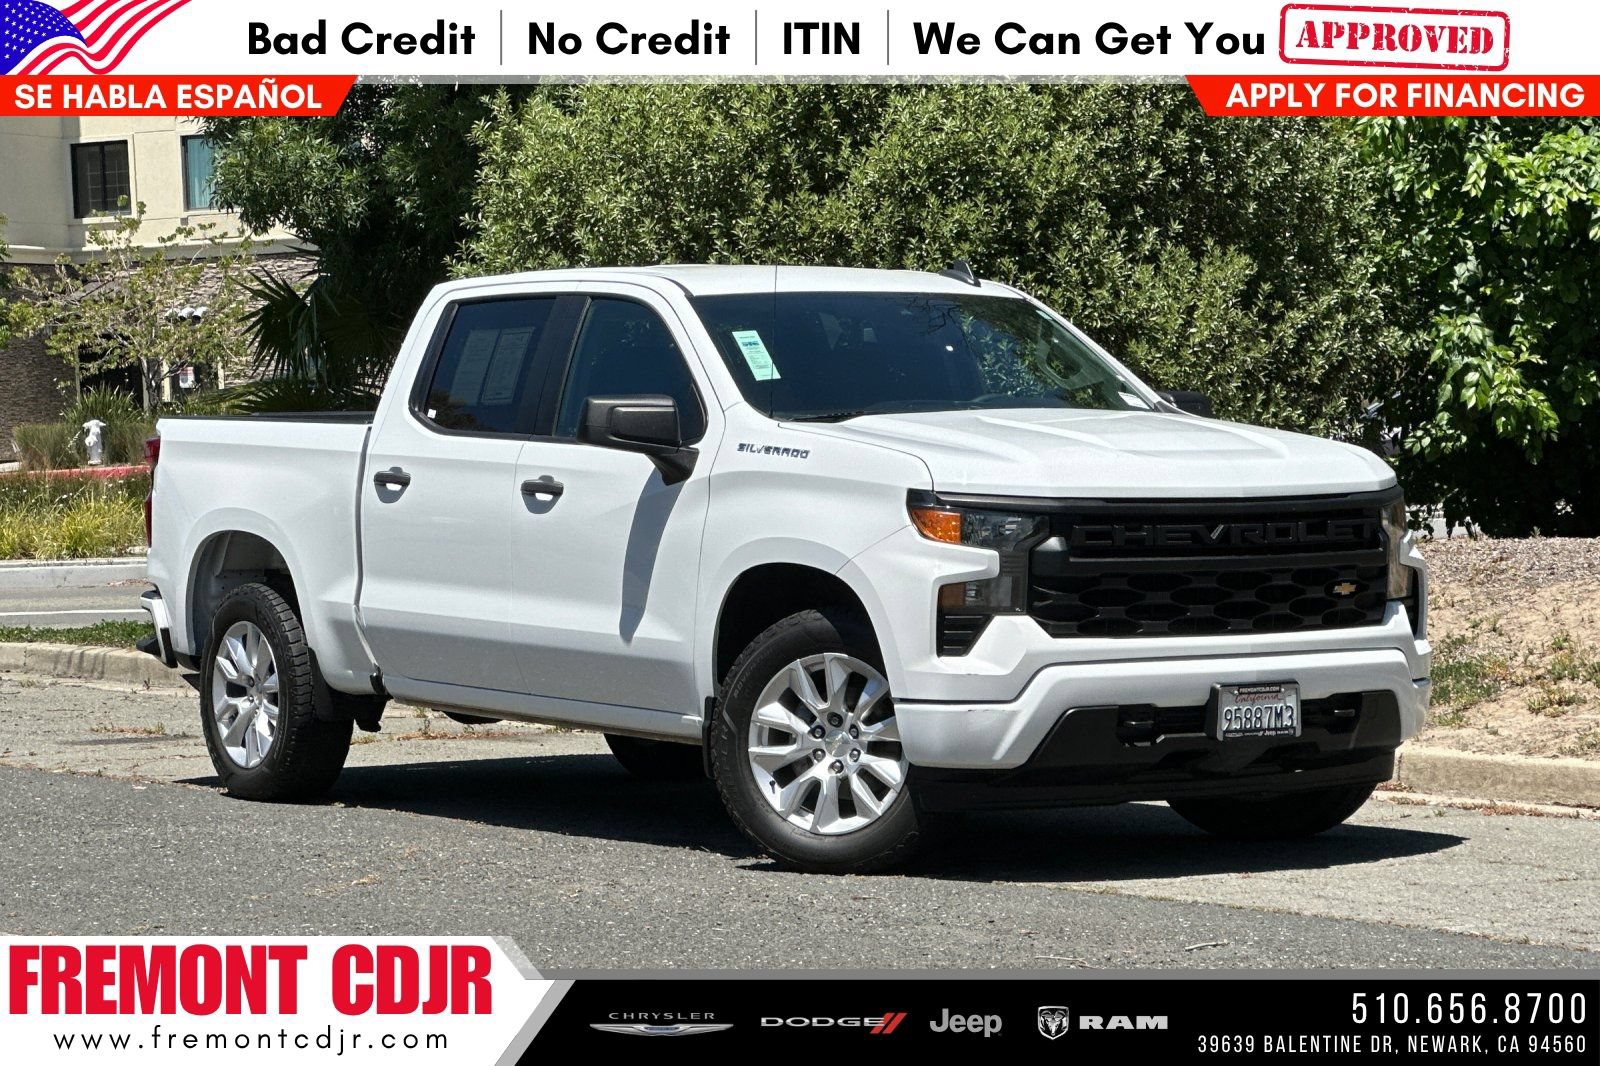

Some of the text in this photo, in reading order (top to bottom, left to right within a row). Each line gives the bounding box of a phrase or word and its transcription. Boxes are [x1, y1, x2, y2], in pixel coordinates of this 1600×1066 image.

[737, 442, 810, 459] SILVERADO
[1071, 517, 1378, 547] CHEVROLET
[1235, 693, 1281, 703] California
[1223, 703, 1295, 731] 95887M3
